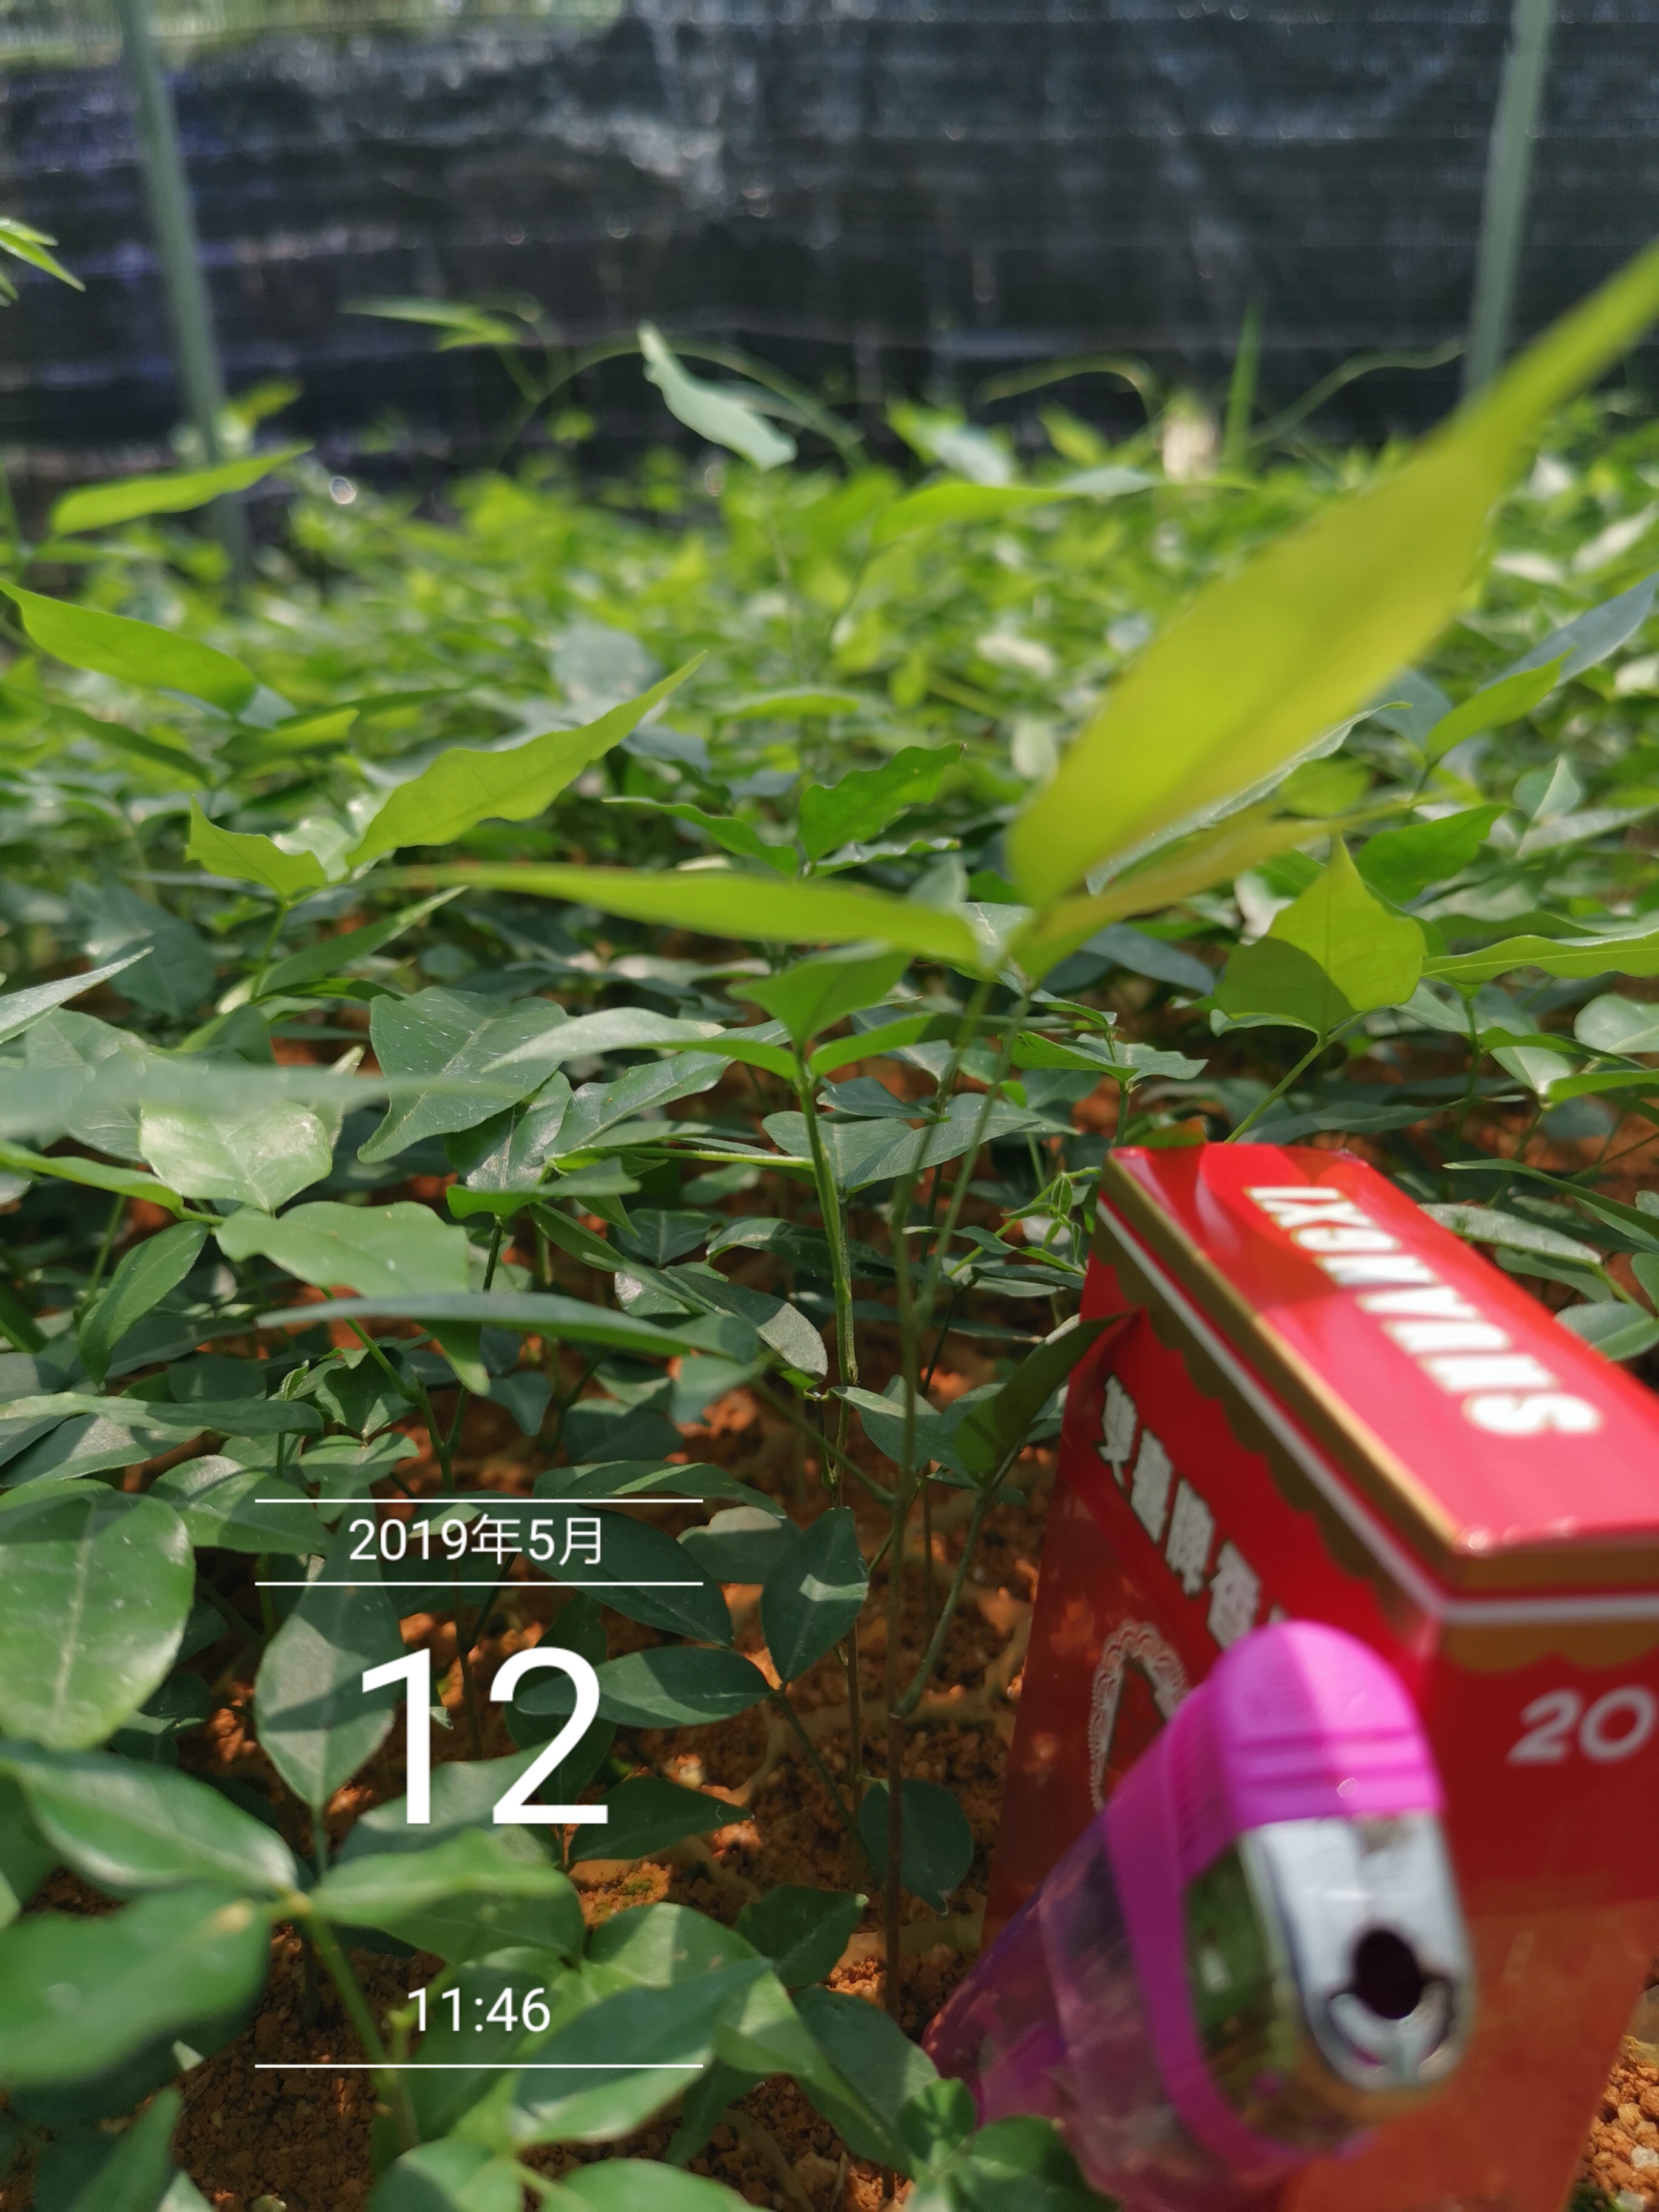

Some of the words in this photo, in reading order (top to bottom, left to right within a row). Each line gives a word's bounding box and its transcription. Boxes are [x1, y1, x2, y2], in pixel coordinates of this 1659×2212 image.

[1244, 1186, 1602, 1435] SHUANGXI
[1099, 1373, 1288, 1652] 雙喜牌香
[1505, 1684, 1658, 1763] 20
